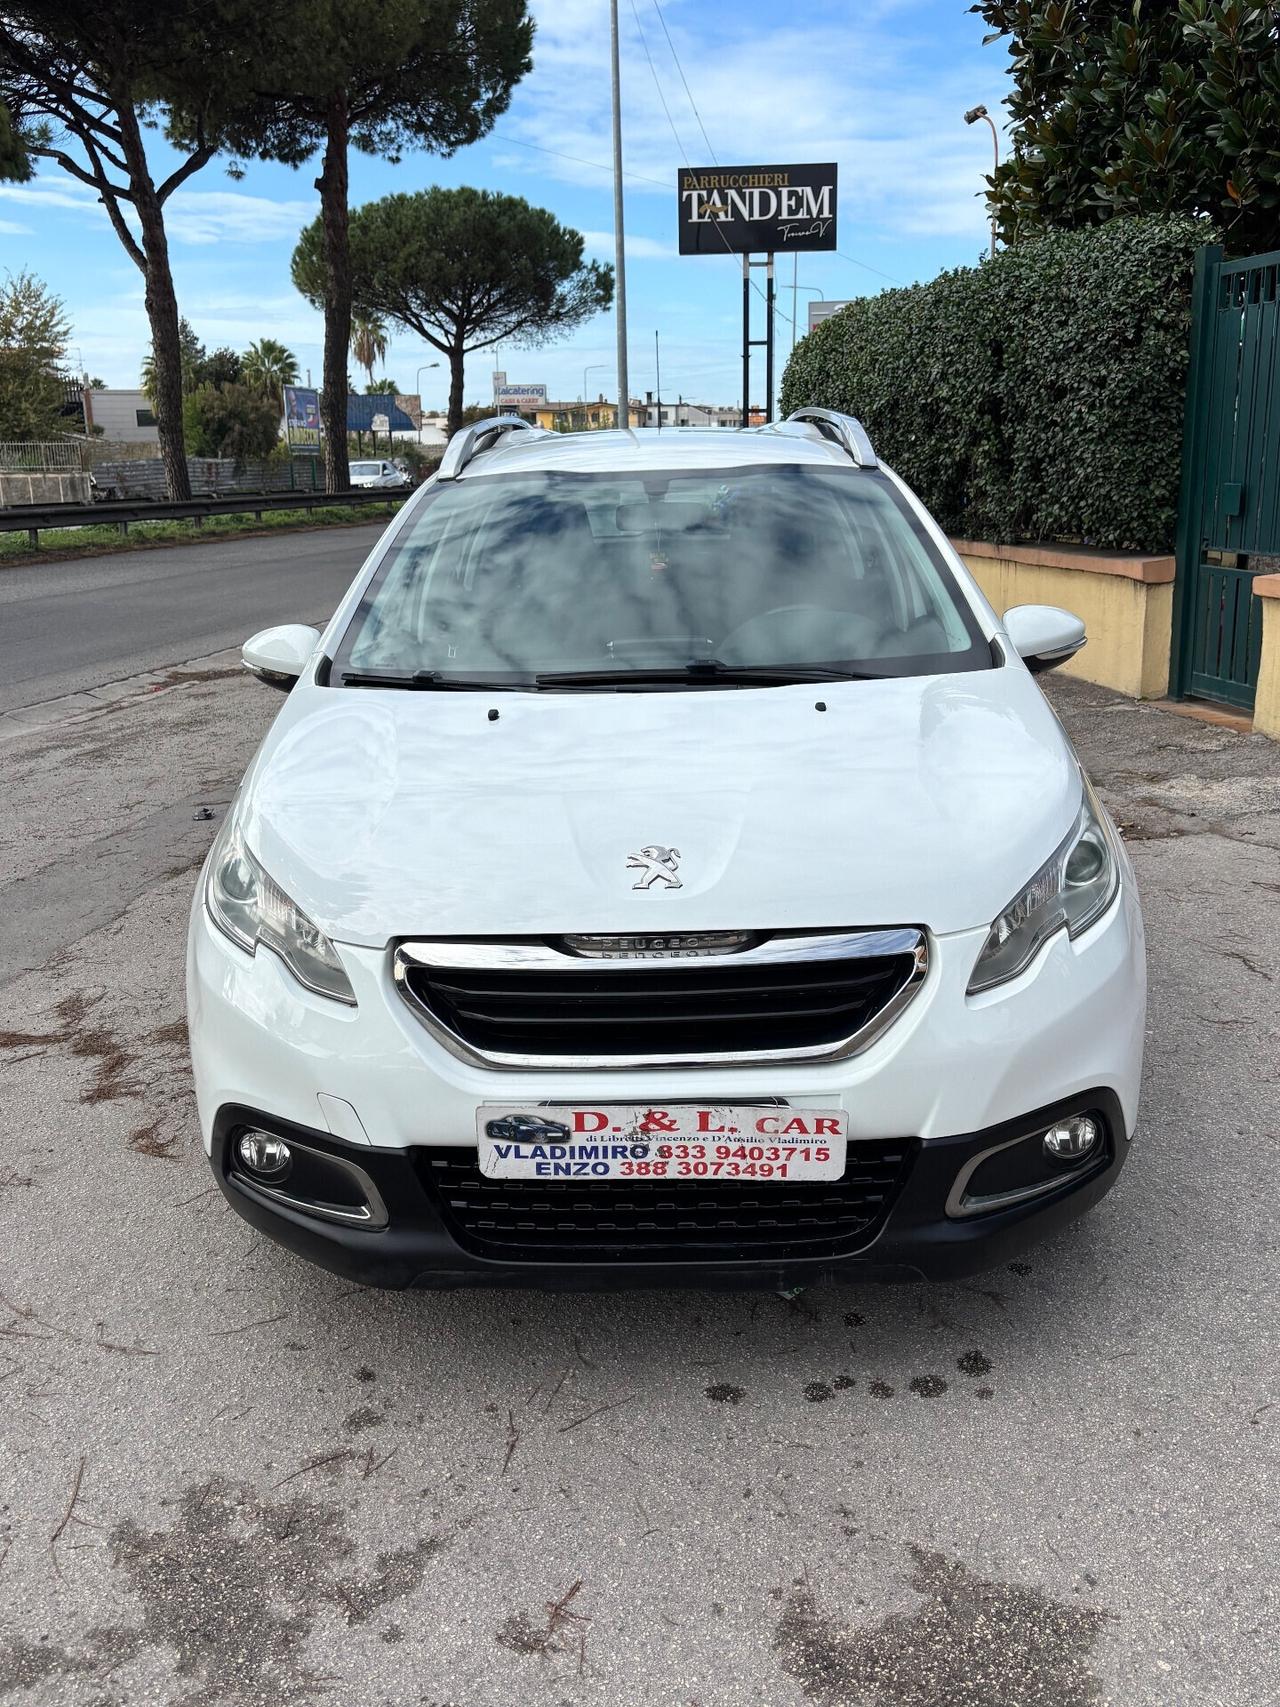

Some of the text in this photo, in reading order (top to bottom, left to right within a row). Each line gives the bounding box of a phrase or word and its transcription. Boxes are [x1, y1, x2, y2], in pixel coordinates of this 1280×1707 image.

[683, 173, 789, 189] PARRUCCHIERI
[682, 186, 834, 222] TANDEM
[602, 937, 715, 949] PEUGEOT
[572, 1111, 622, 1133] D.
[639, 1109, 681, 1133] &
[755, 1117, 843, 1135] CAR
[586, 1135, 597, 1143] di
[645, 1135, 700, 1143] Vincenzo
[769, 1136, 827, 1145] Vladimiro
[494, 1144, 650, 1160] VLADIMIRO
[715, 1146, 830, 1162] 9403715
[535, 1161, 789, 1178] ENZO 388 3073491
